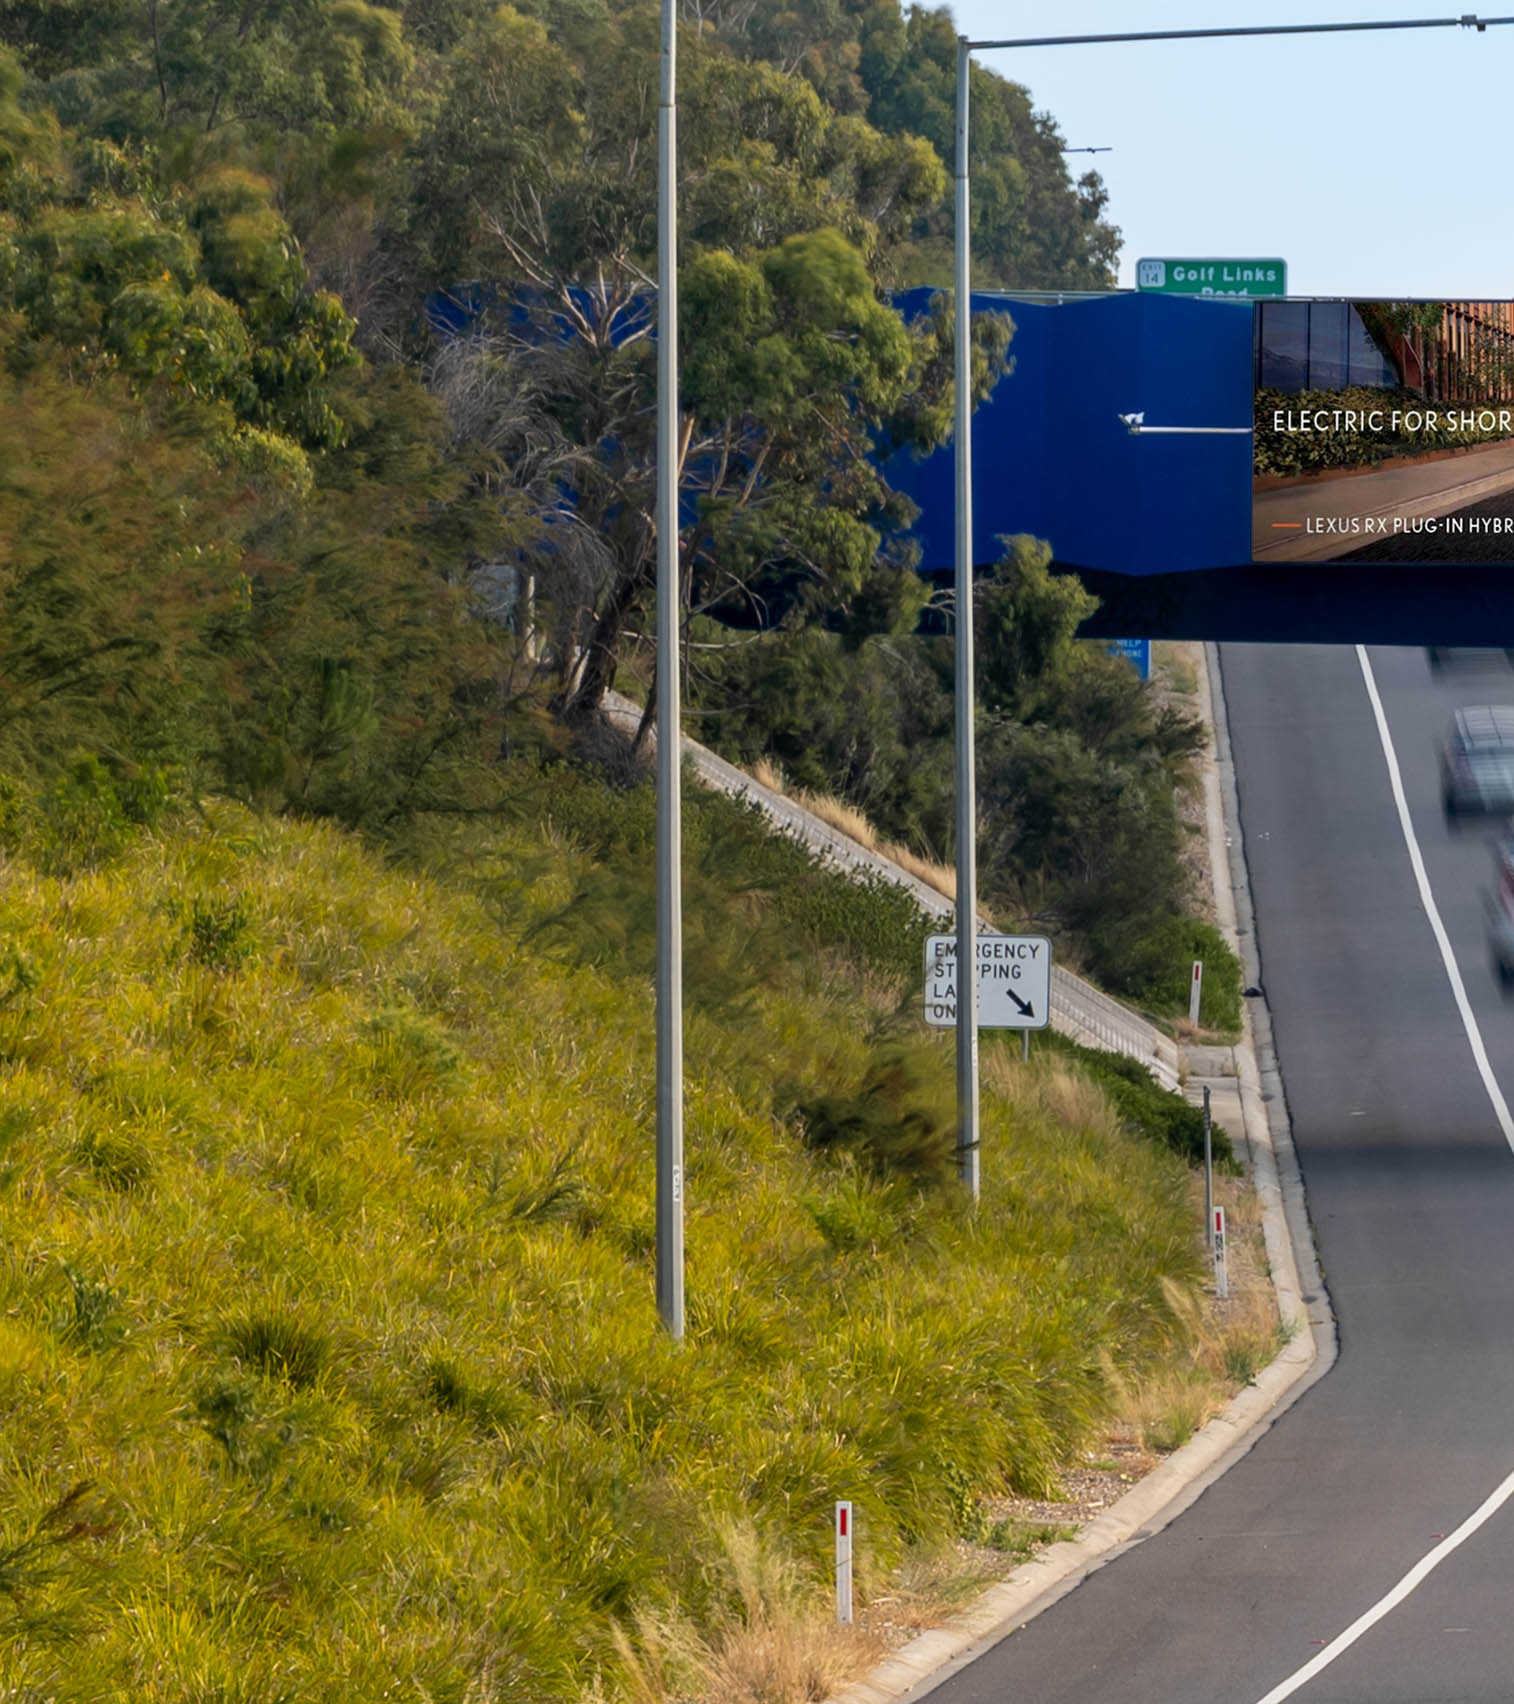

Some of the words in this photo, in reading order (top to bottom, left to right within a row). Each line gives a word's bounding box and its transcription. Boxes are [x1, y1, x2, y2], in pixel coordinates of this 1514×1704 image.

[1145, 272, 1159, 284] 14
[1173, 266, 1215, 281] Golf
[1223, 266, 1277, 281] Links
[1273, 410, 1383, 431] ELECTRIC
[1392, 410, 1438, 431] FOR
[1307, 517, 1360, 533] LEXUS
[1364, 517, 1388, 533] RX
[1393, 517, 1463, 533] PLUG-IN
[934, 943, 1039, 959] EMGENCY
[934, 963, 1021, 979] STPING
